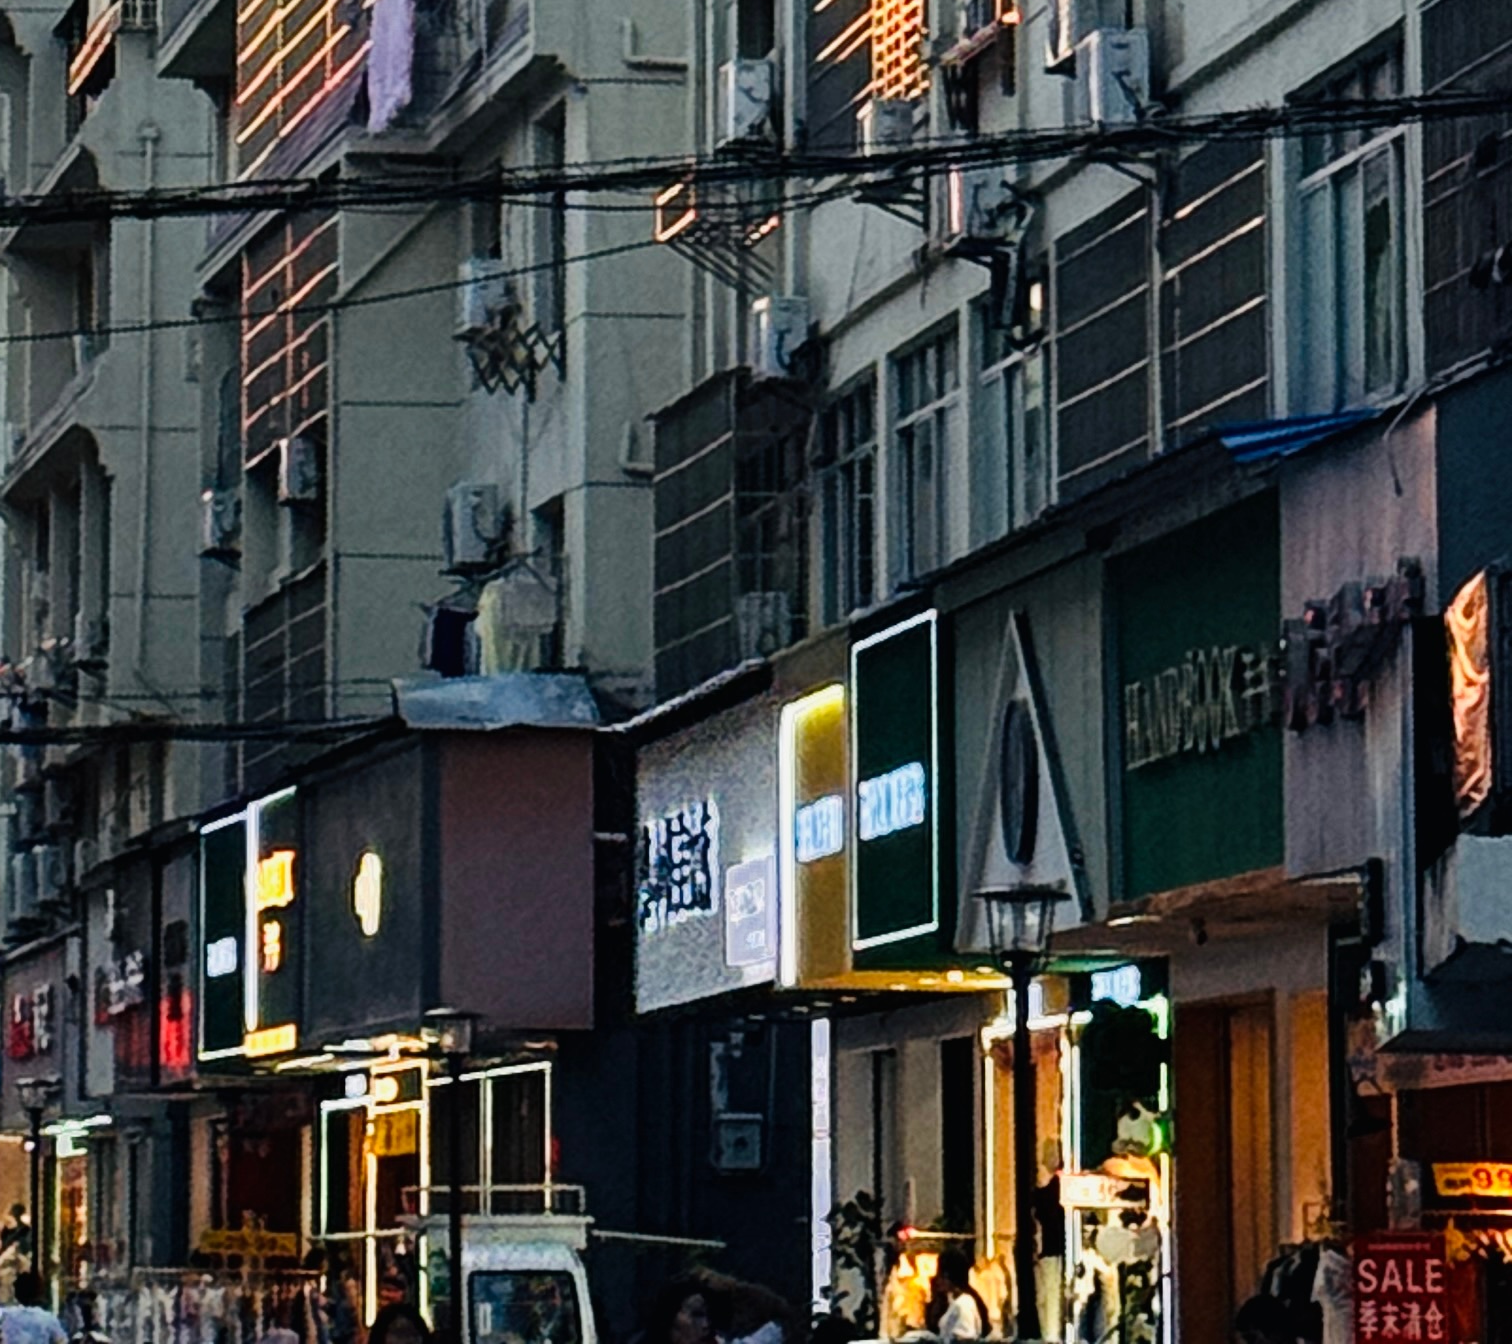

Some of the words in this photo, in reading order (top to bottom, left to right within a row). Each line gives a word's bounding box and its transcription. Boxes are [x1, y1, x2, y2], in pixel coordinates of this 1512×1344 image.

[1358, 1259, 1444, 1294] SALE
[1359, 1300, 1444, 1341] 季末清仓
